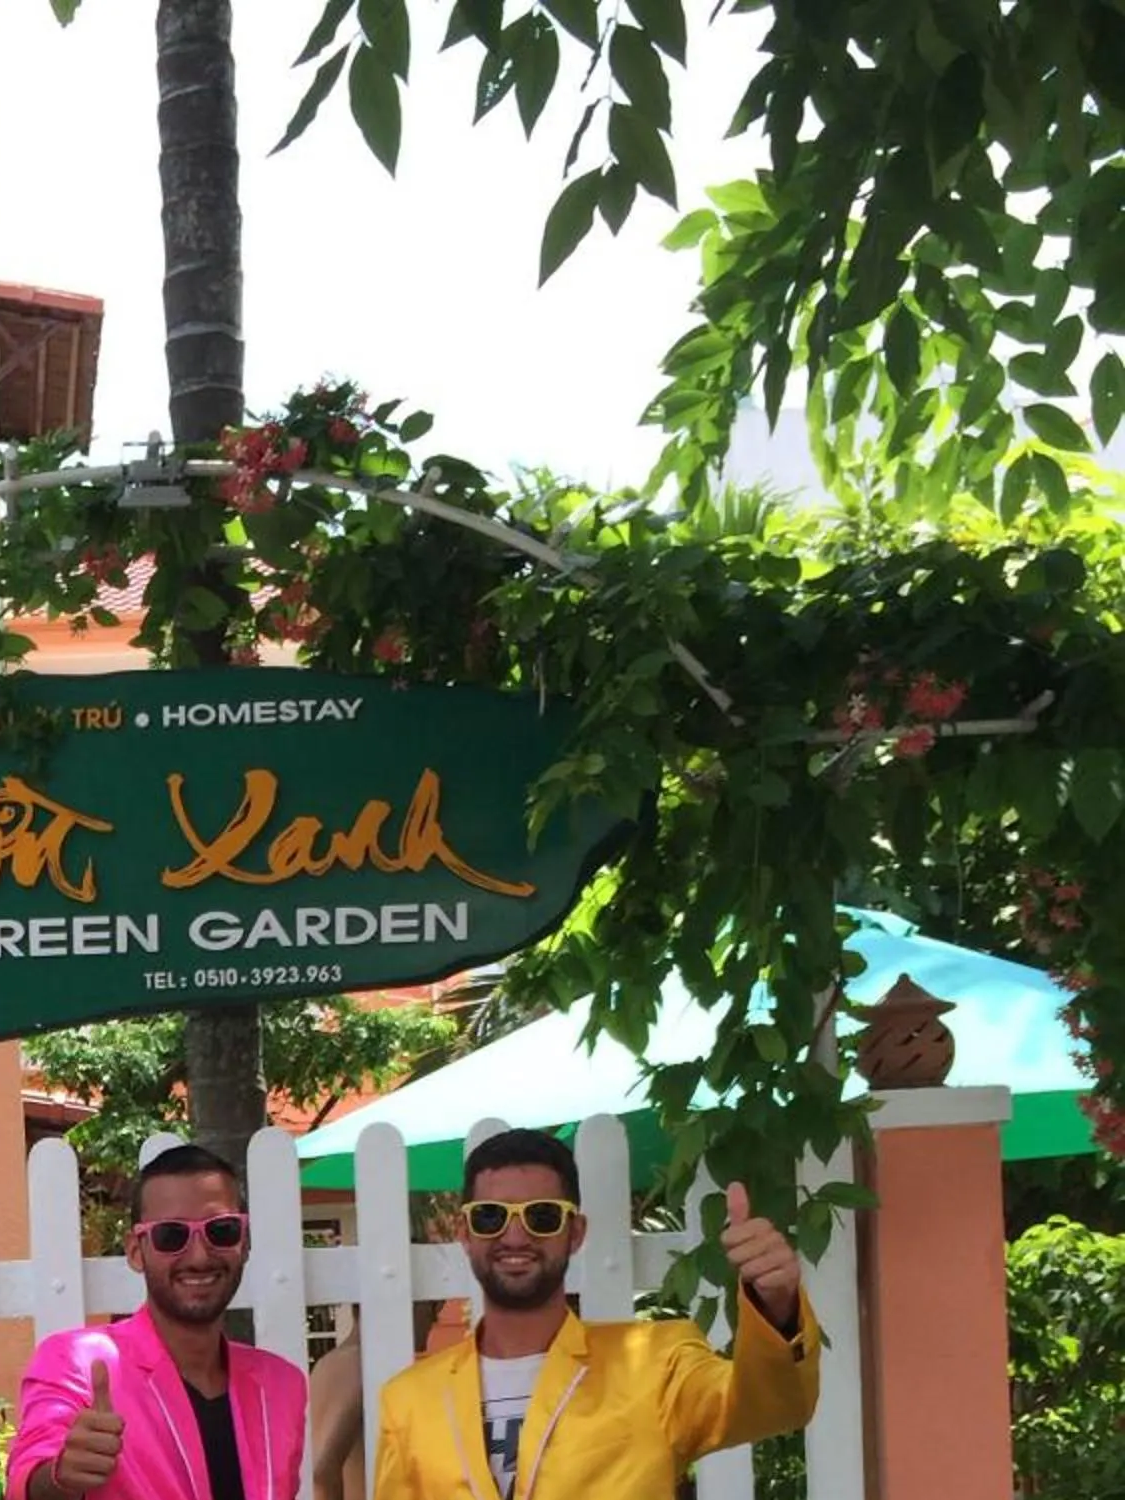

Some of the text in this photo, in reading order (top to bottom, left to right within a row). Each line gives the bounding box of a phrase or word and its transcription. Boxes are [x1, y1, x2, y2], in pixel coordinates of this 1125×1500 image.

[71, 699, 123, 730] TRÚ
[161, 698, 363, 728] HOMESTAY
[161, 767, 537, 898] Xanh
[187, 901, 469, 951] GARDEN
